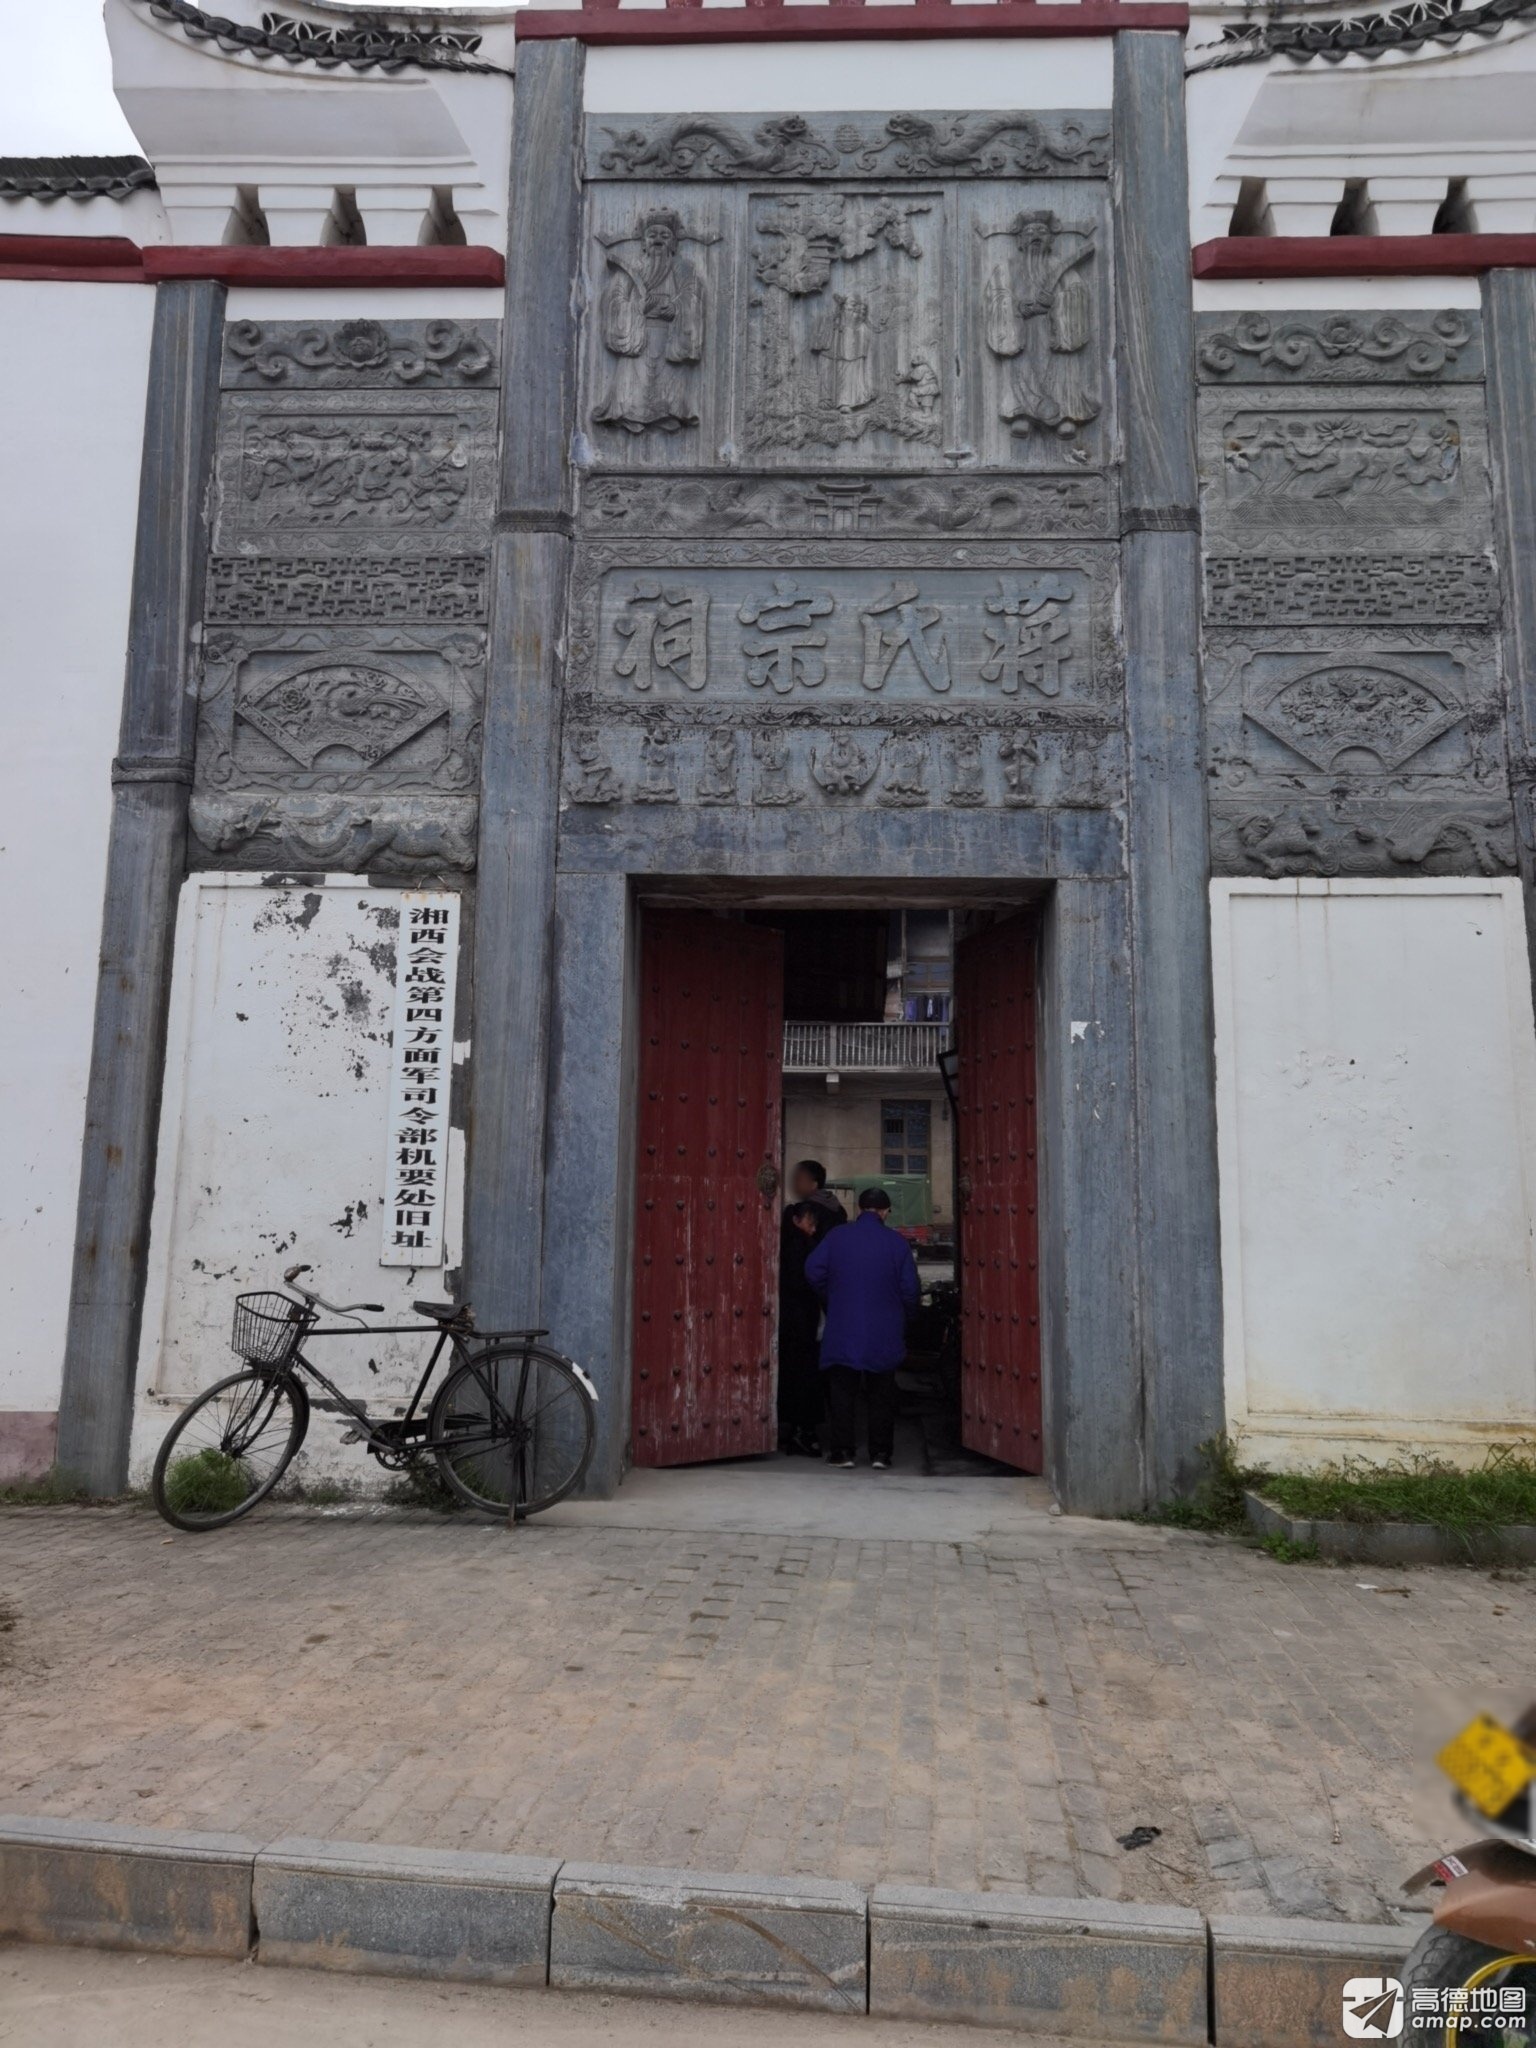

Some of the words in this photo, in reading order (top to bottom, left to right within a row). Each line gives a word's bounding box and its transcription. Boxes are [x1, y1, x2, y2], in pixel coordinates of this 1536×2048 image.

[391, 907, 450, 1248] 湘西会战第四方面军司令部机要处旧址
